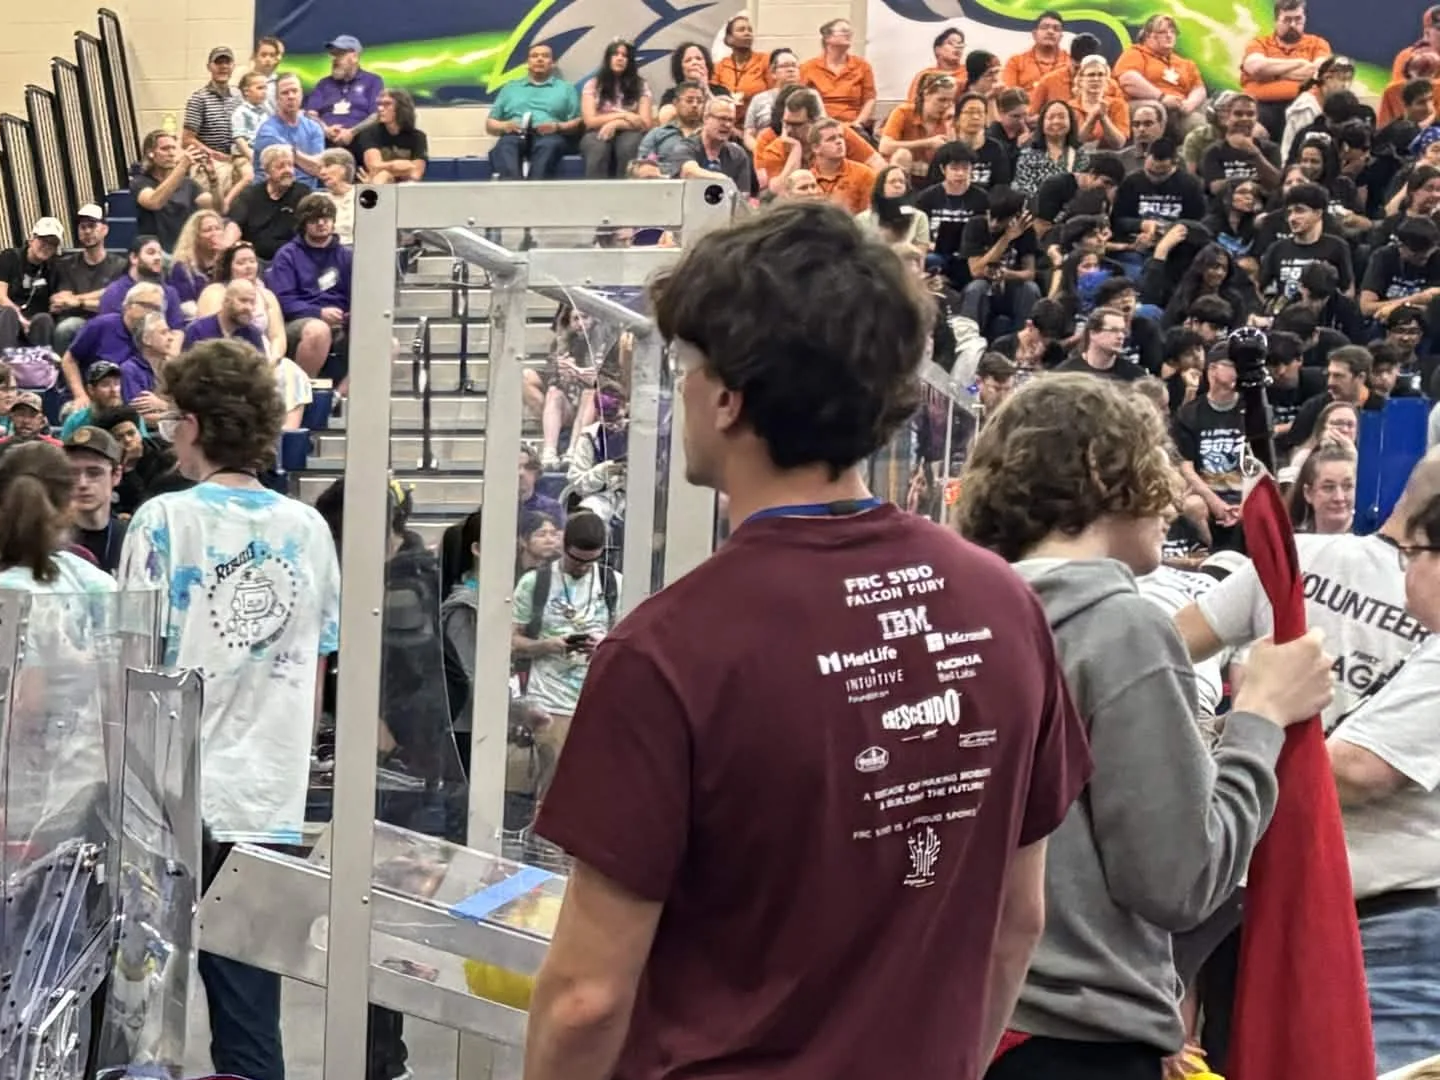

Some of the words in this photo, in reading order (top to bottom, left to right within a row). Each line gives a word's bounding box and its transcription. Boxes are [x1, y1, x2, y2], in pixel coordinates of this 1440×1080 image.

[844, 575, 884, 593] FRC
[887, 565, 934, 585] 5190
[846, 587, 903, 607] FALCON
[908, 578, 945, 596] FURY
[1302, 571, 1431, 643] OLUNTEER
[877, 605, 932, 640] IBM
[842, 646, 898, 668] MetLife
[936, 654, 983, 671] NOKIA
[846, 668, 904, 693] INTUITIVE
[882, 688, 960, 730] CRESCENDO
